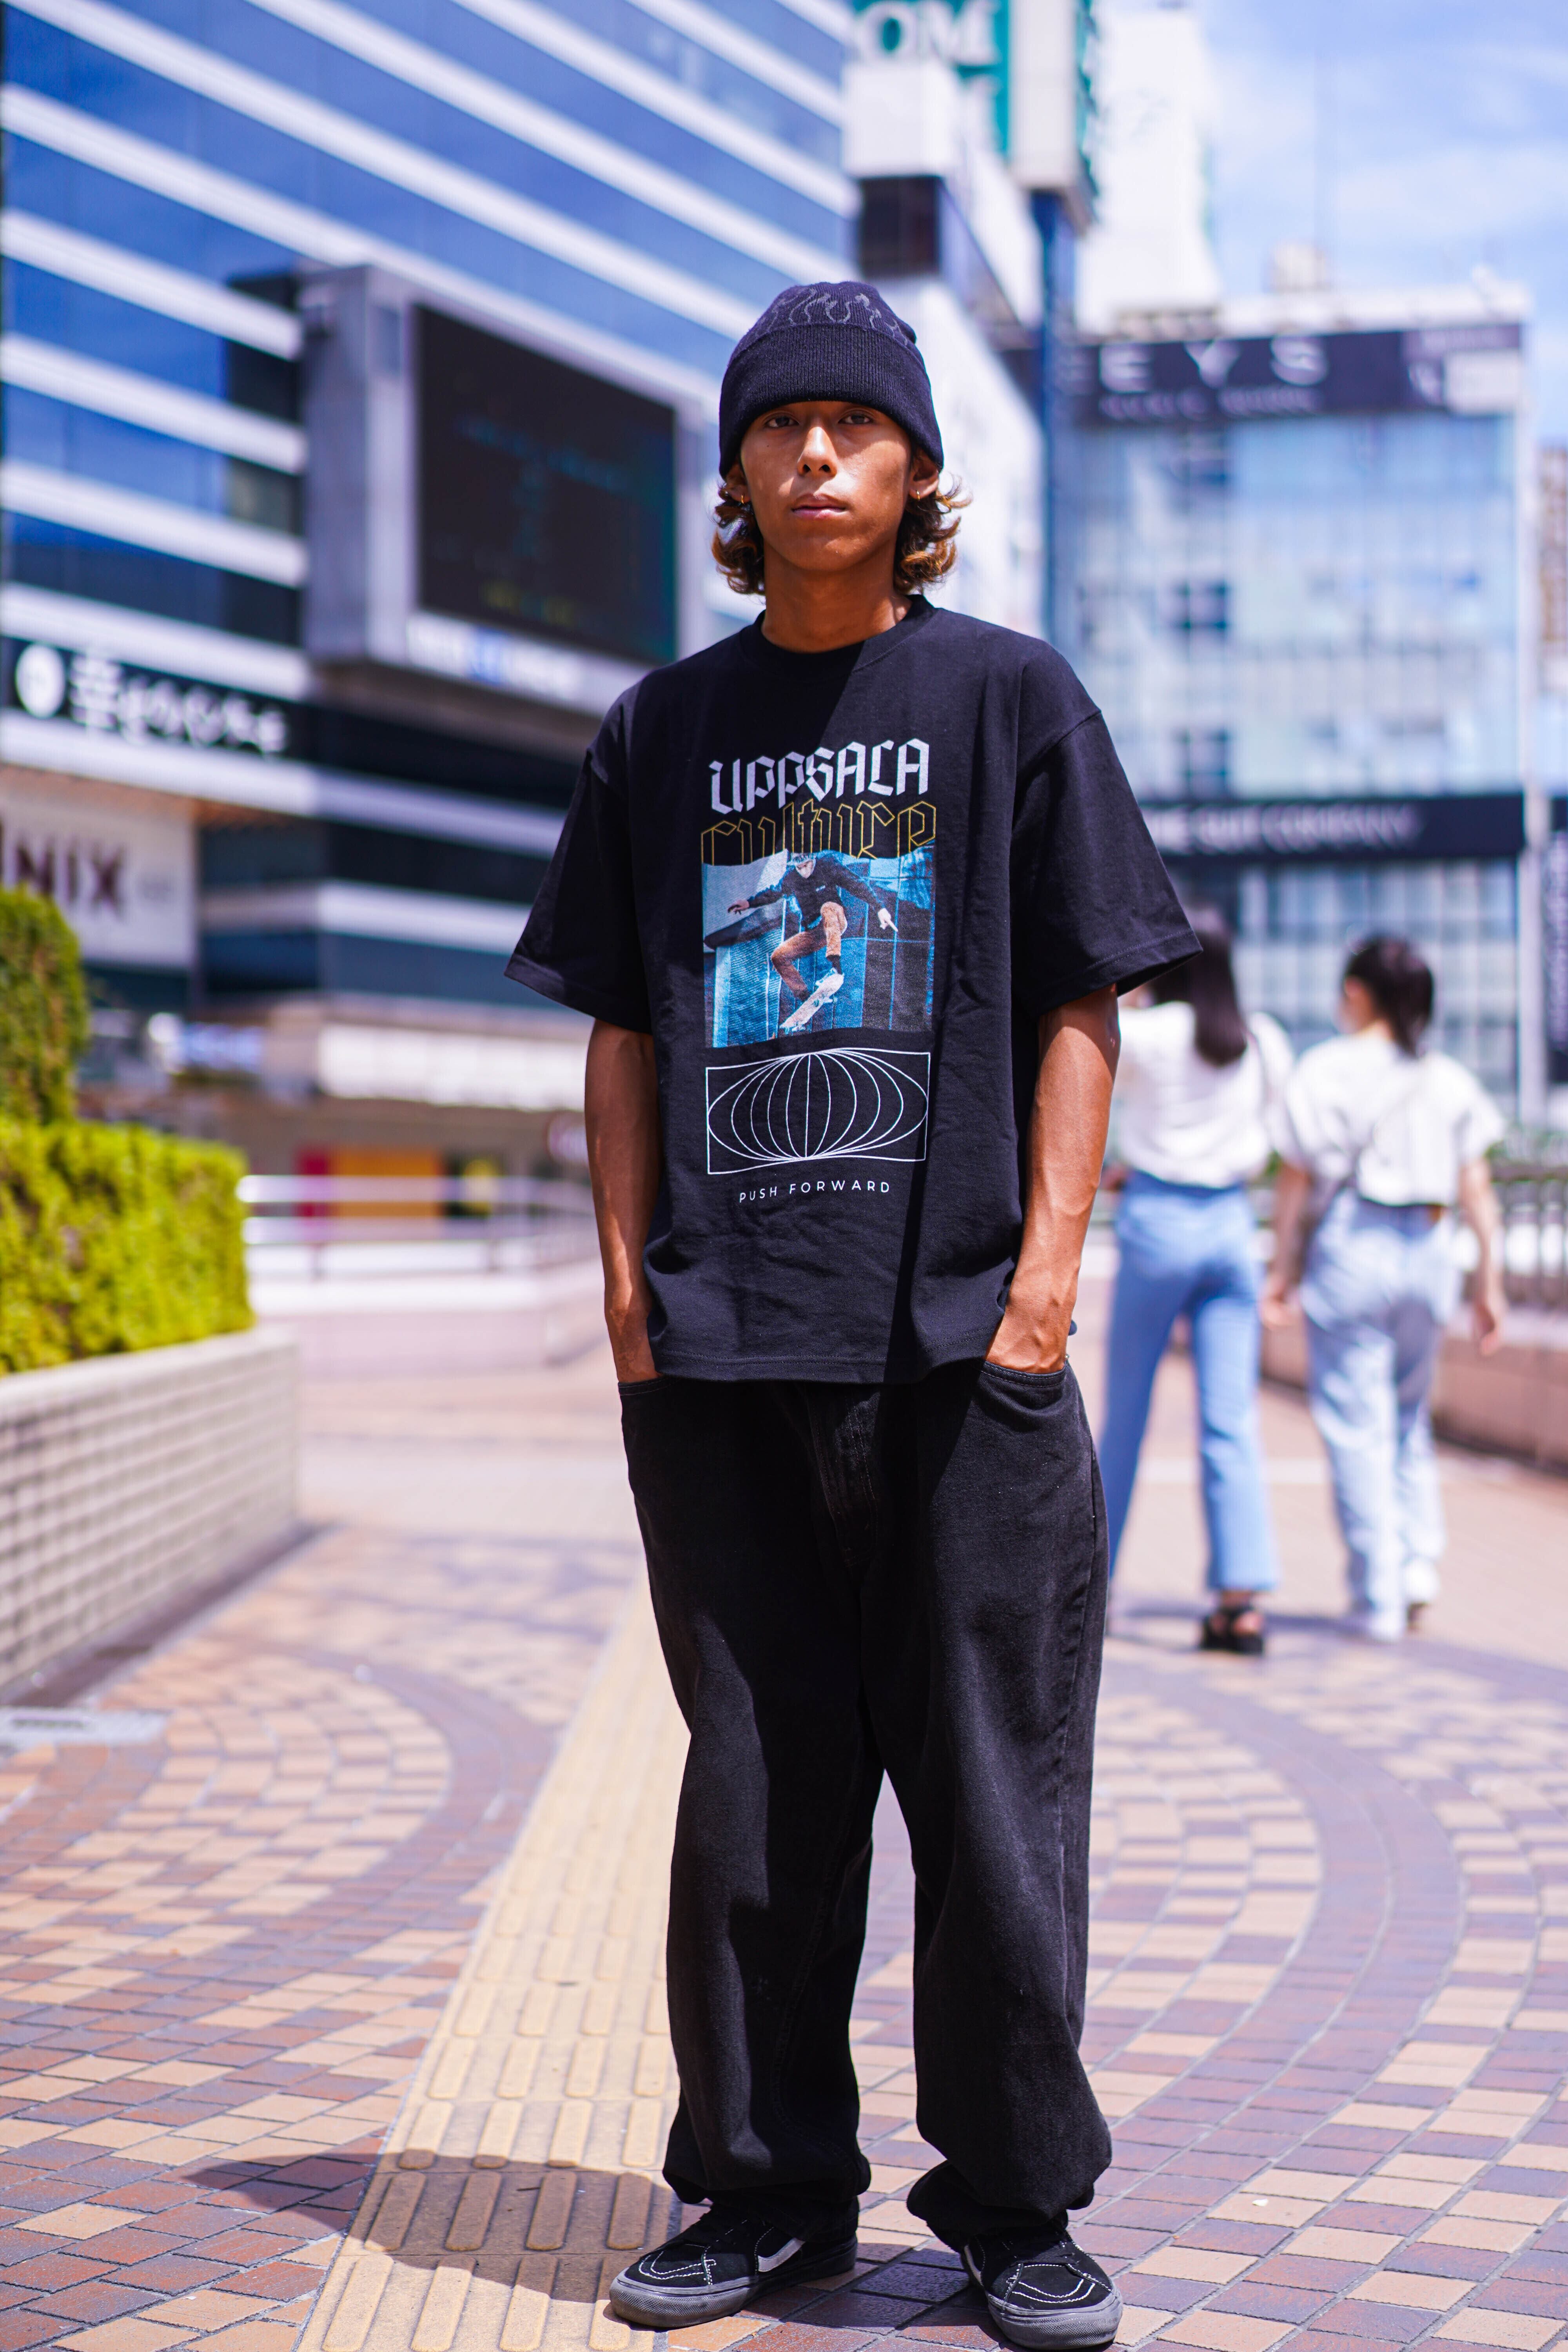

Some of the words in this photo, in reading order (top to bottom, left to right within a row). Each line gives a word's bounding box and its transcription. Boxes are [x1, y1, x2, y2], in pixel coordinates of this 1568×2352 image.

[708, 738, 929, 814] UPPSALA
[739, 1186, 777, 1203] PUSH
[789, 1180, 890, 1194] FORWARD
